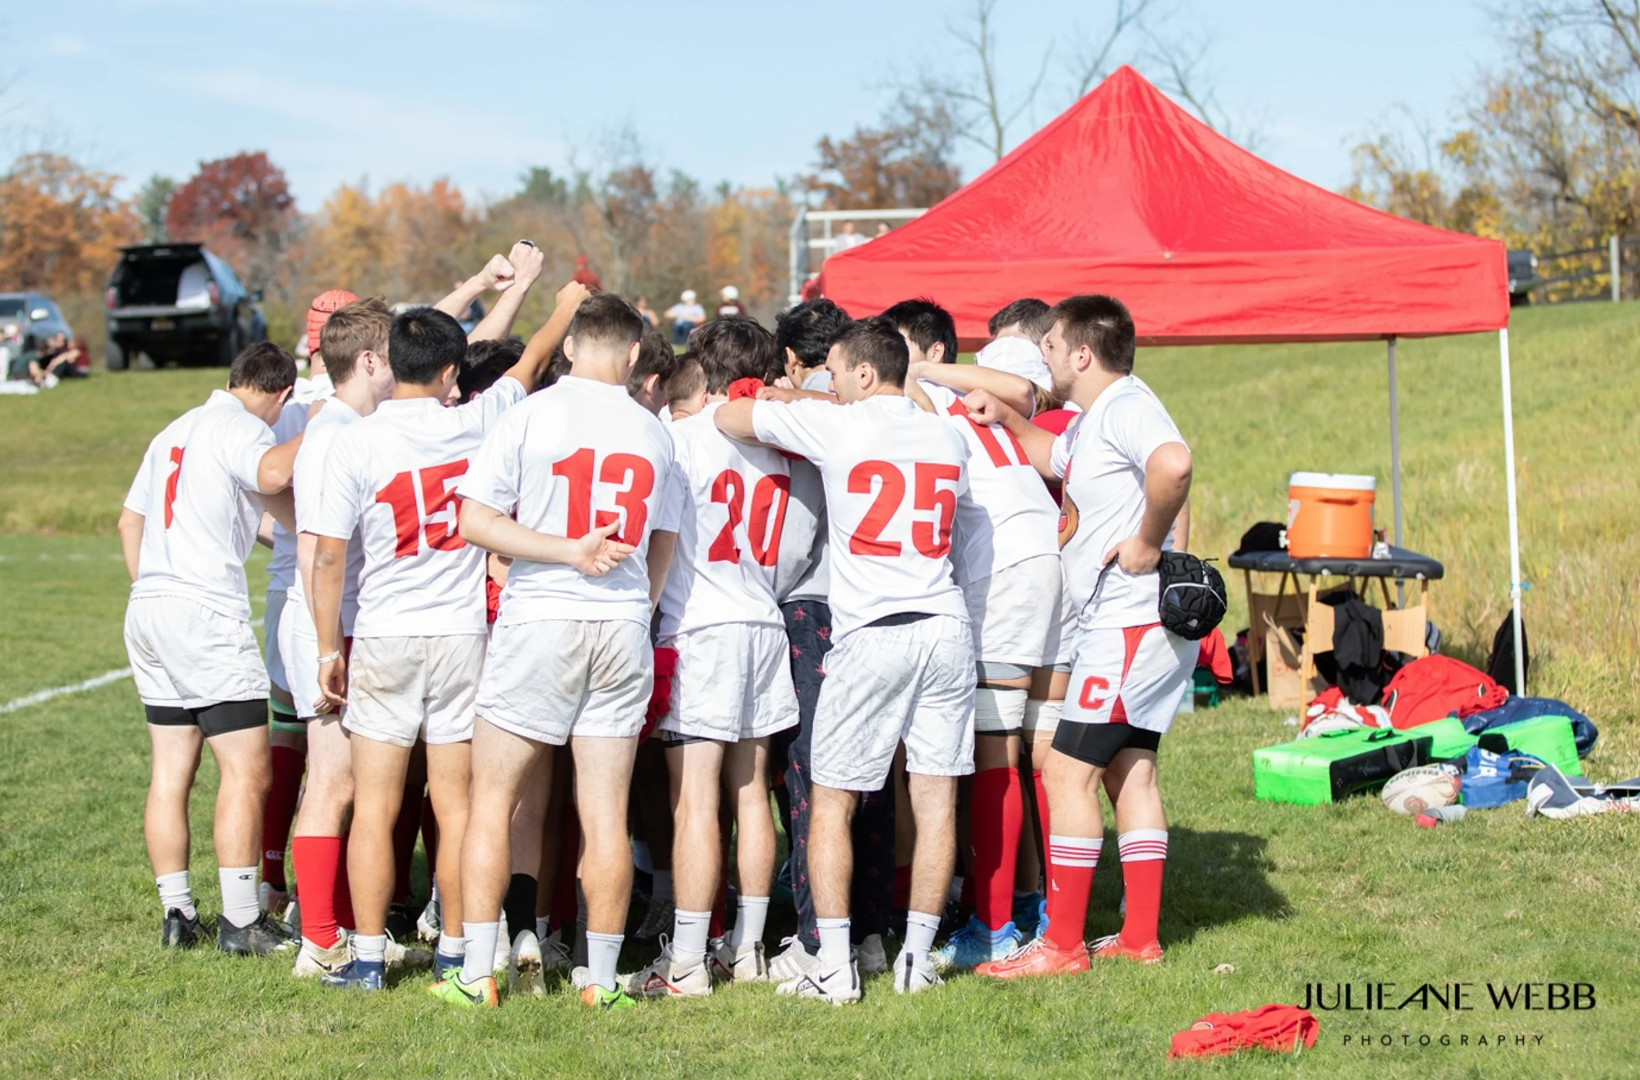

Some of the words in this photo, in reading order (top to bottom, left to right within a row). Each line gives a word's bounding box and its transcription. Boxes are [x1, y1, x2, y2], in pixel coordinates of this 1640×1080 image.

[375, 458, 470, 559] 15
[552, 448, 655, 548] 13
[708, 469, 790, 567] 20
[847, 459, 960, 560] 25
[1078, 676, 1110, 711] C
